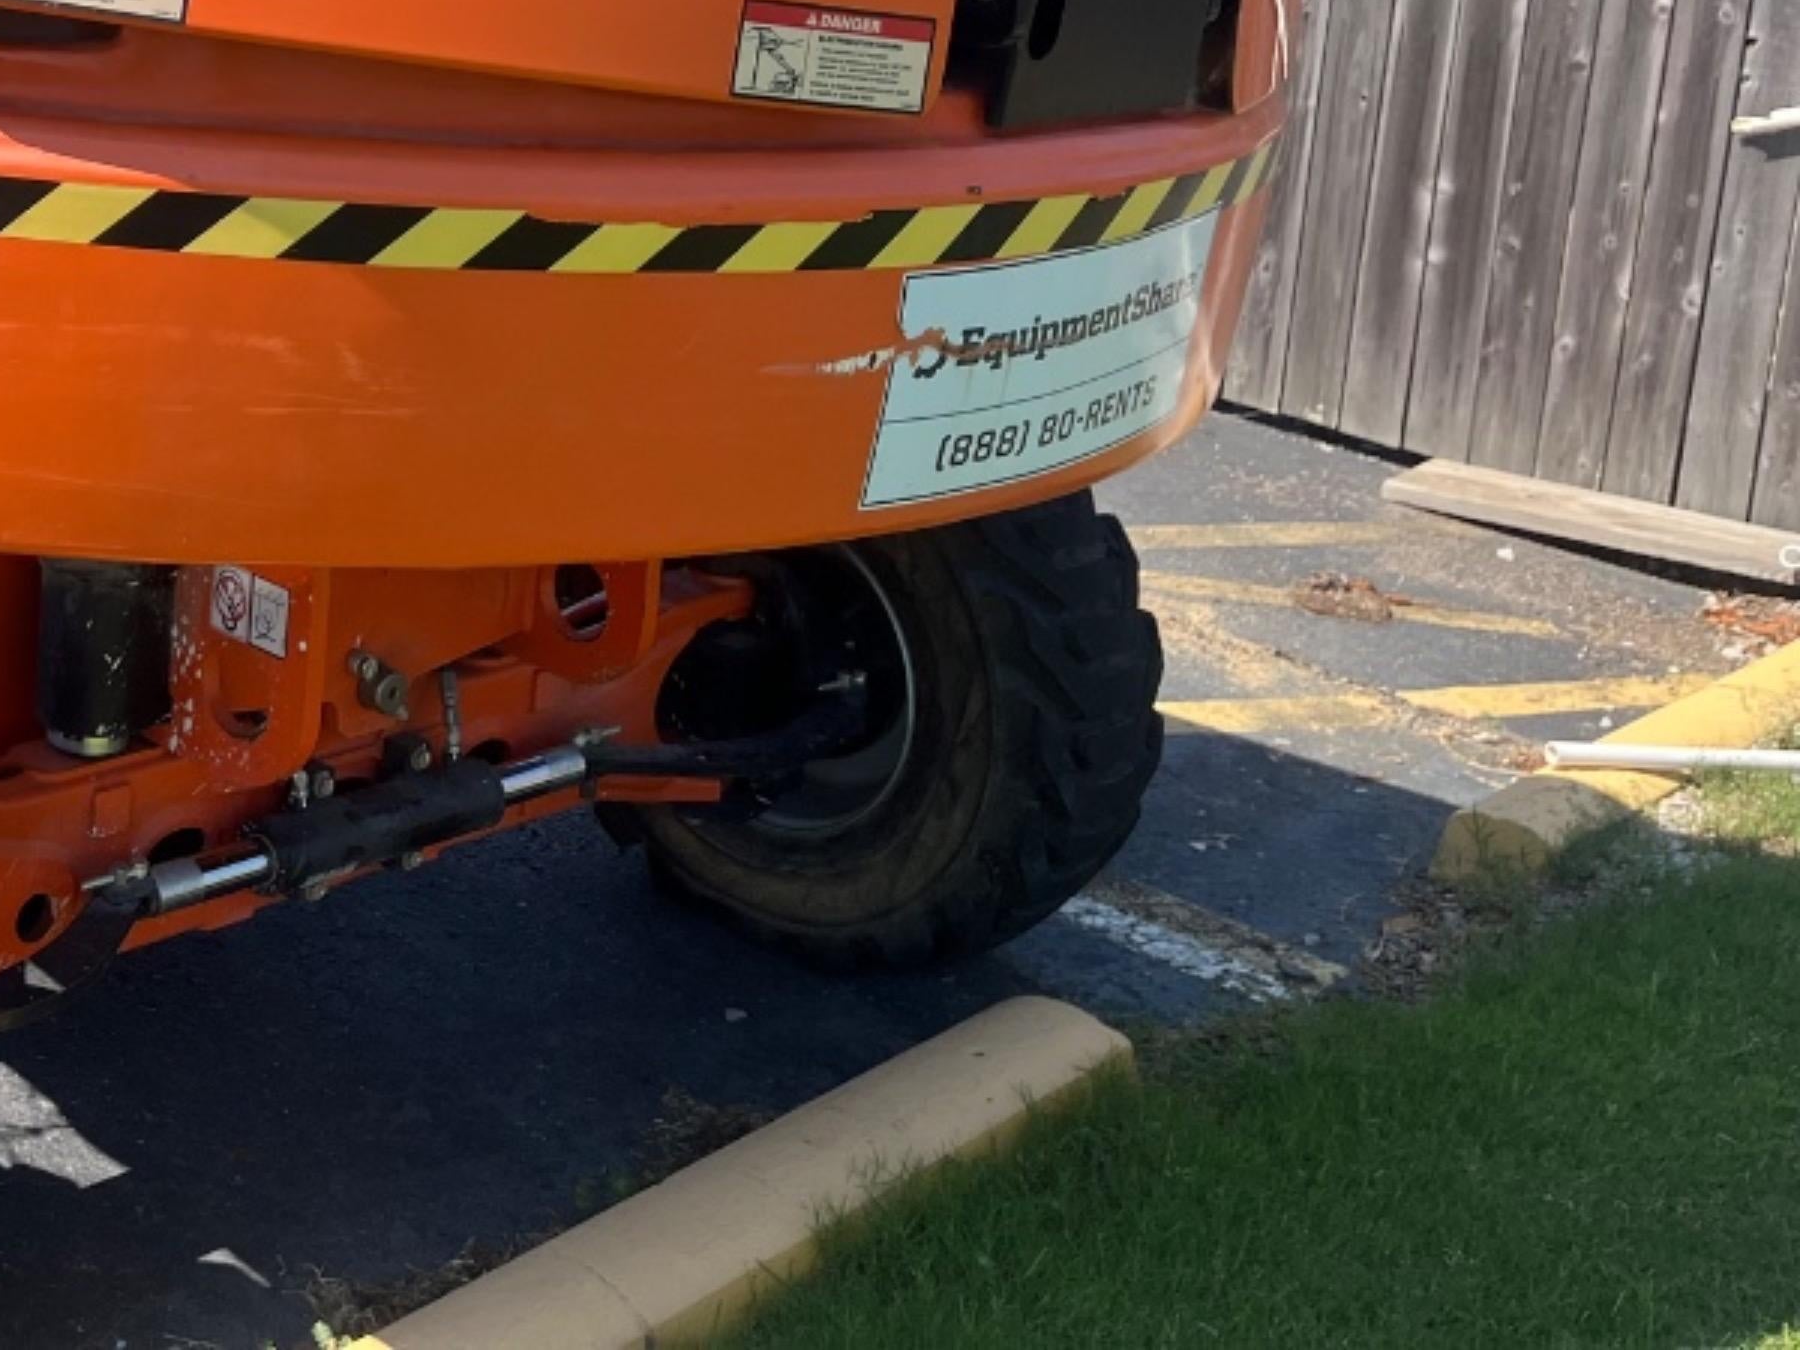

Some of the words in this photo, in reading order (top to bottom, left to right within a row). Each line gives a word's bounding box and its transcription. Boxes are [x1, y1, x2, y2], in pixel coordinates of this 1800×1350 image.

[821, 14, 883, 34] DANGER
[935, 419, 1030, 472] (888)
[1037, 375, 1158, 448] 80-RENTS
